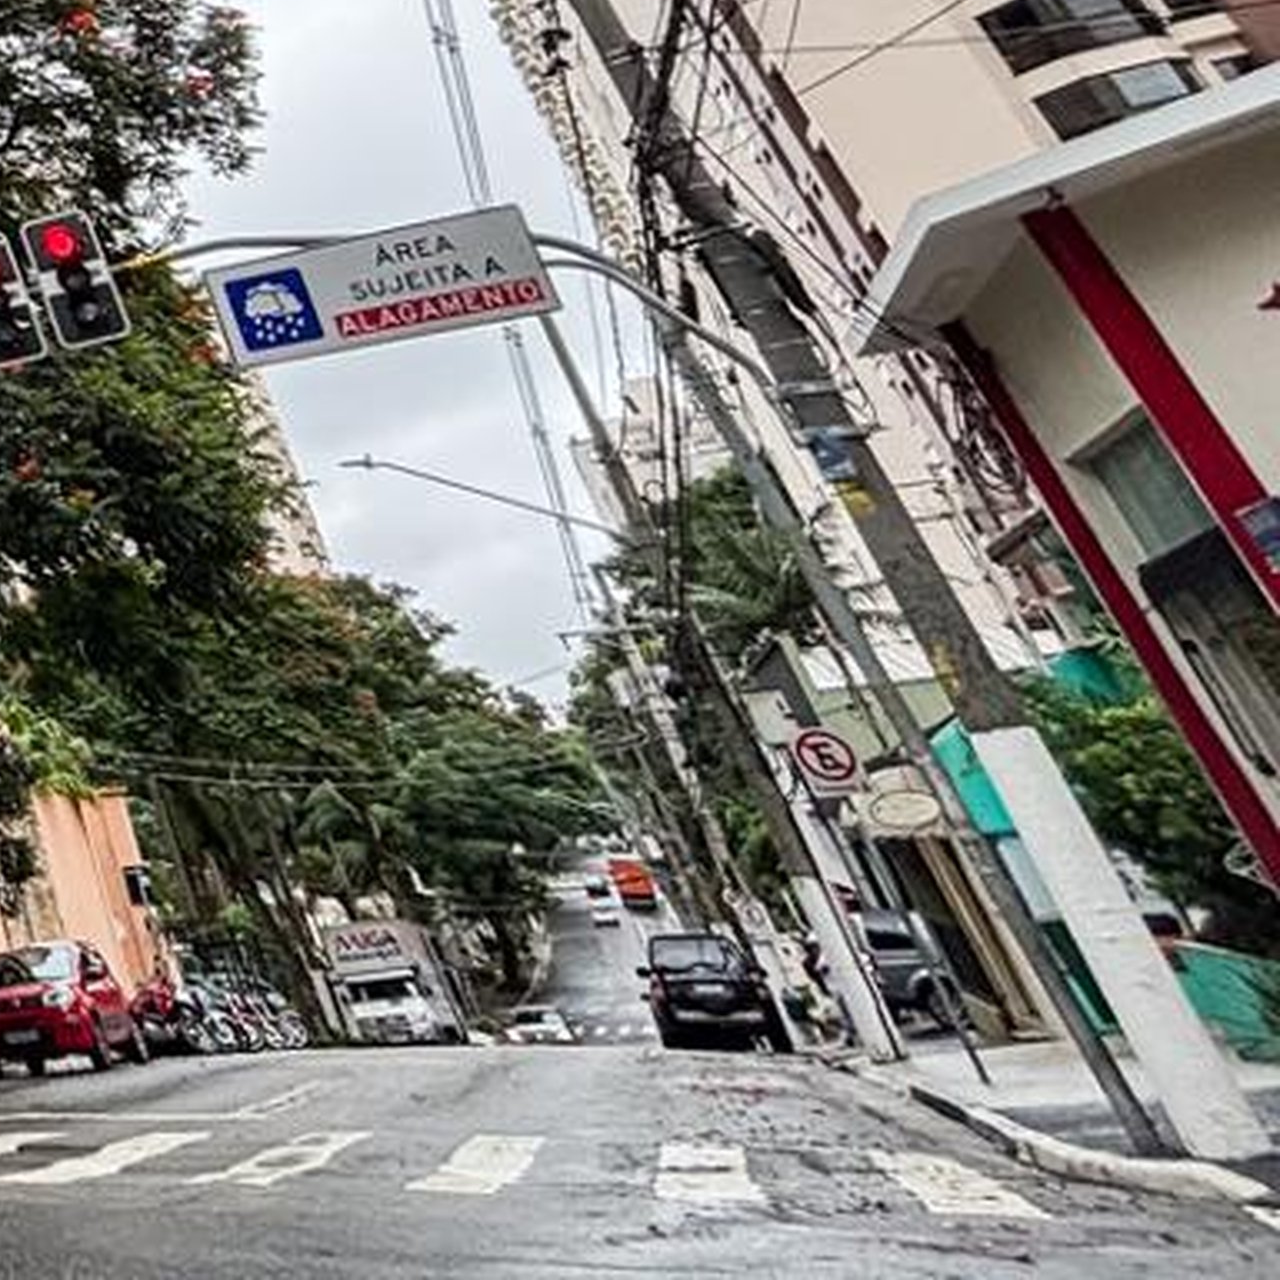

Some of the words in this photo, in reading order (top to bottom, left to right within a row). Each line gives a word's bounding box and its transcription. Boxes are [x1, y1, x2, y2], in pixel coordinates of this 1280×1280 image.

[375, 235, 456, 267] ÁREA
[349, 263, 473, 302] SUJEITA
[485, 255, 507, 276] A
[341, 279, 539, 336] ALAGAMENTO
